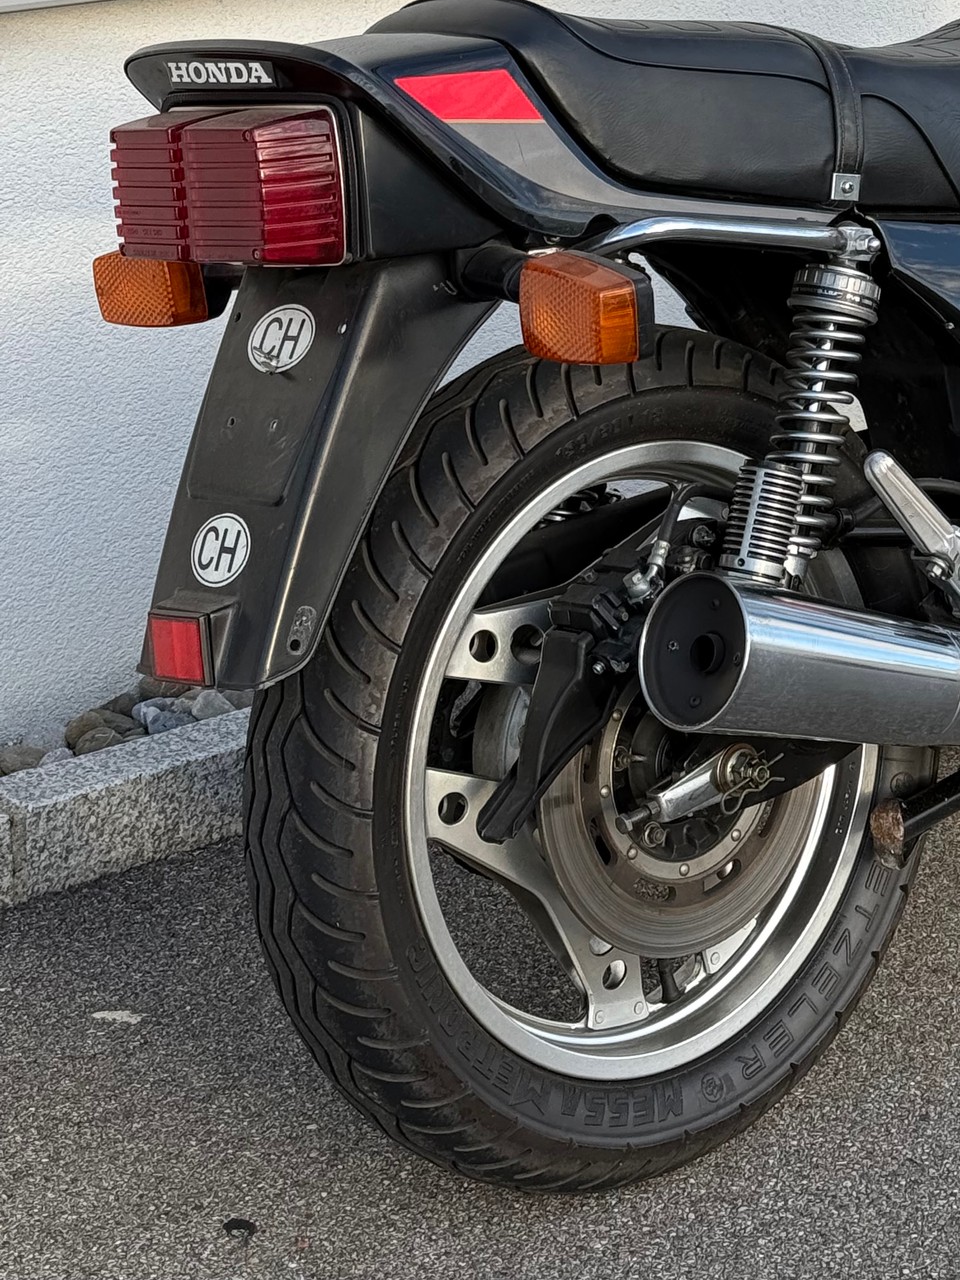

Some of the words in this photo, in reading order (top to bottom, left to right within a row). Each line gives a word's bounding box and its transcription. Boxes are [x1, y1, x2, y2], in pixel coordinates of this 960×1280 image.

[167, 61, 273, 86] HONDA
[259, 316, 306, 361] CH
[199, 525, 244, 574] CH
[736, 861, 893, 1080] ETZELER
